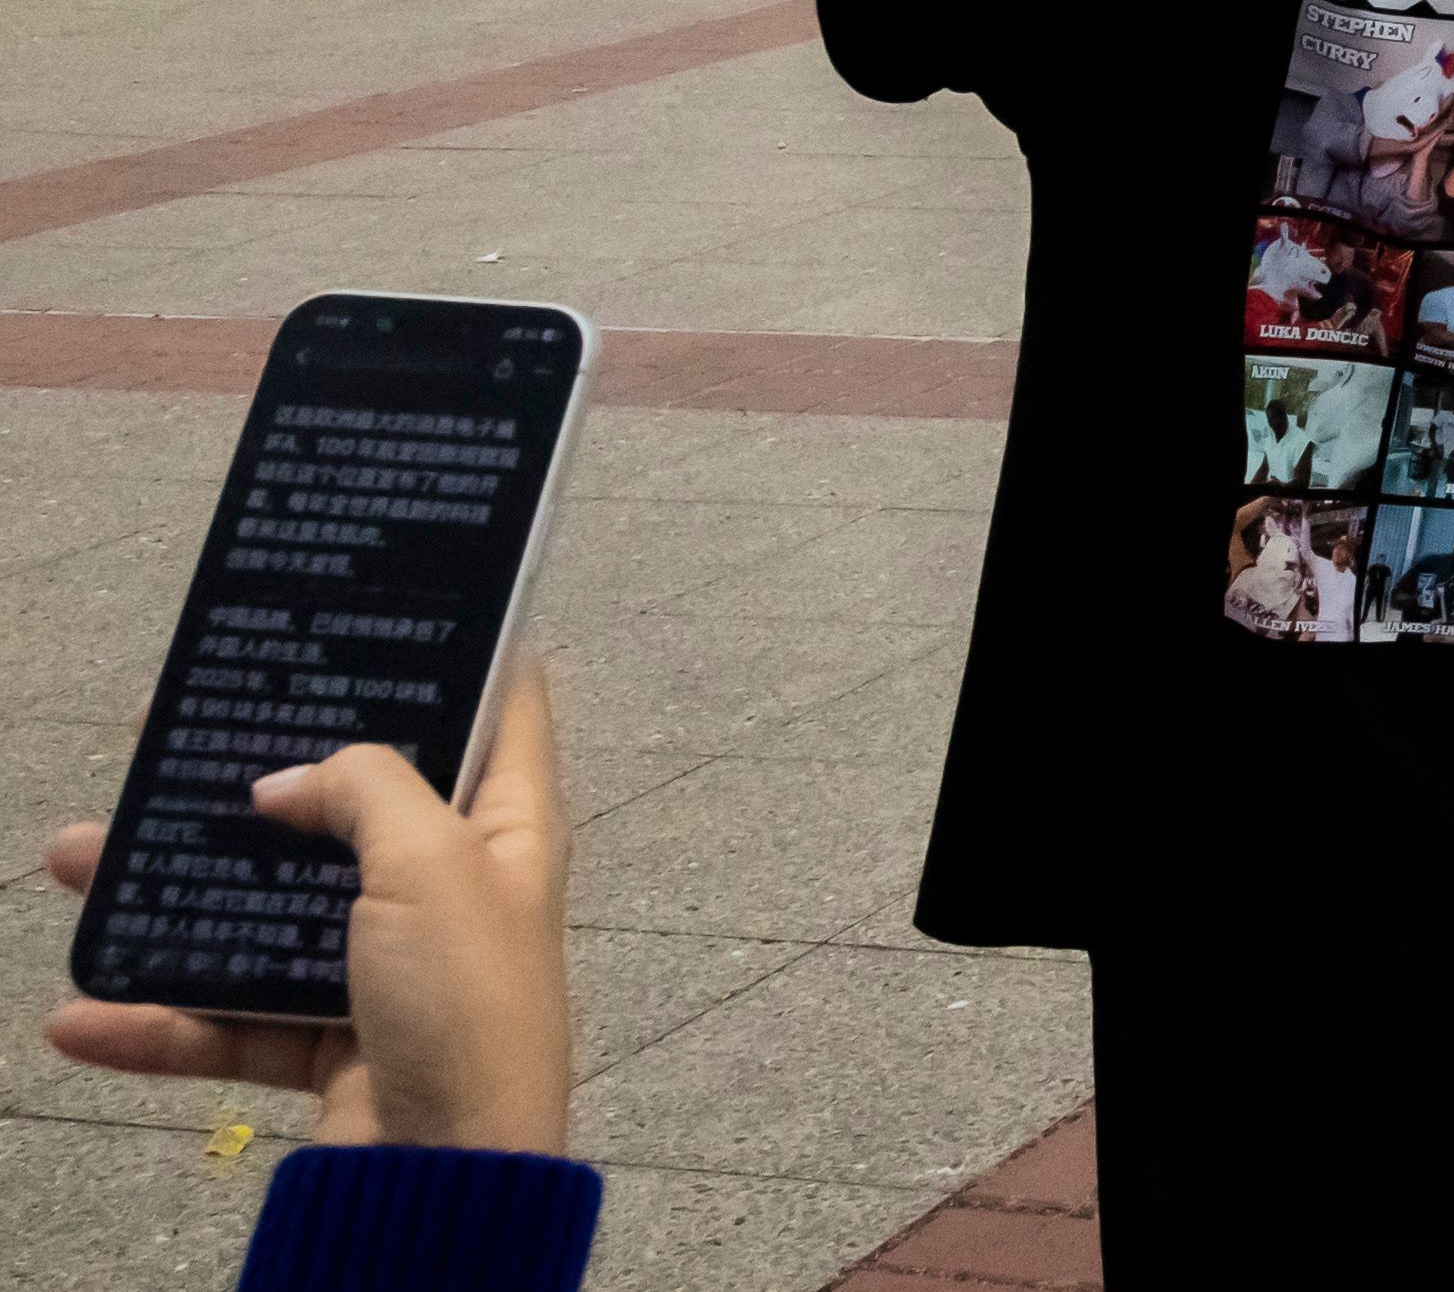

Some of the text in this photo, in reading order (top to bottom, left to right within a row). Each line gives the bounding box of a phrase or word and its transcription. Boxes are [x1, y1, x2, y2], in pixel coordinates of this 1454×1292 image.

[1305, 3, 1415, 43] STEPHEN
[1301, 33, 1379, 72] CURRY
[1260, 324, 1370, 347] LUKA DONCIC
[1251, 365, 1291, 380] AKON
[1384, 621, 1432, 634] JAMES
